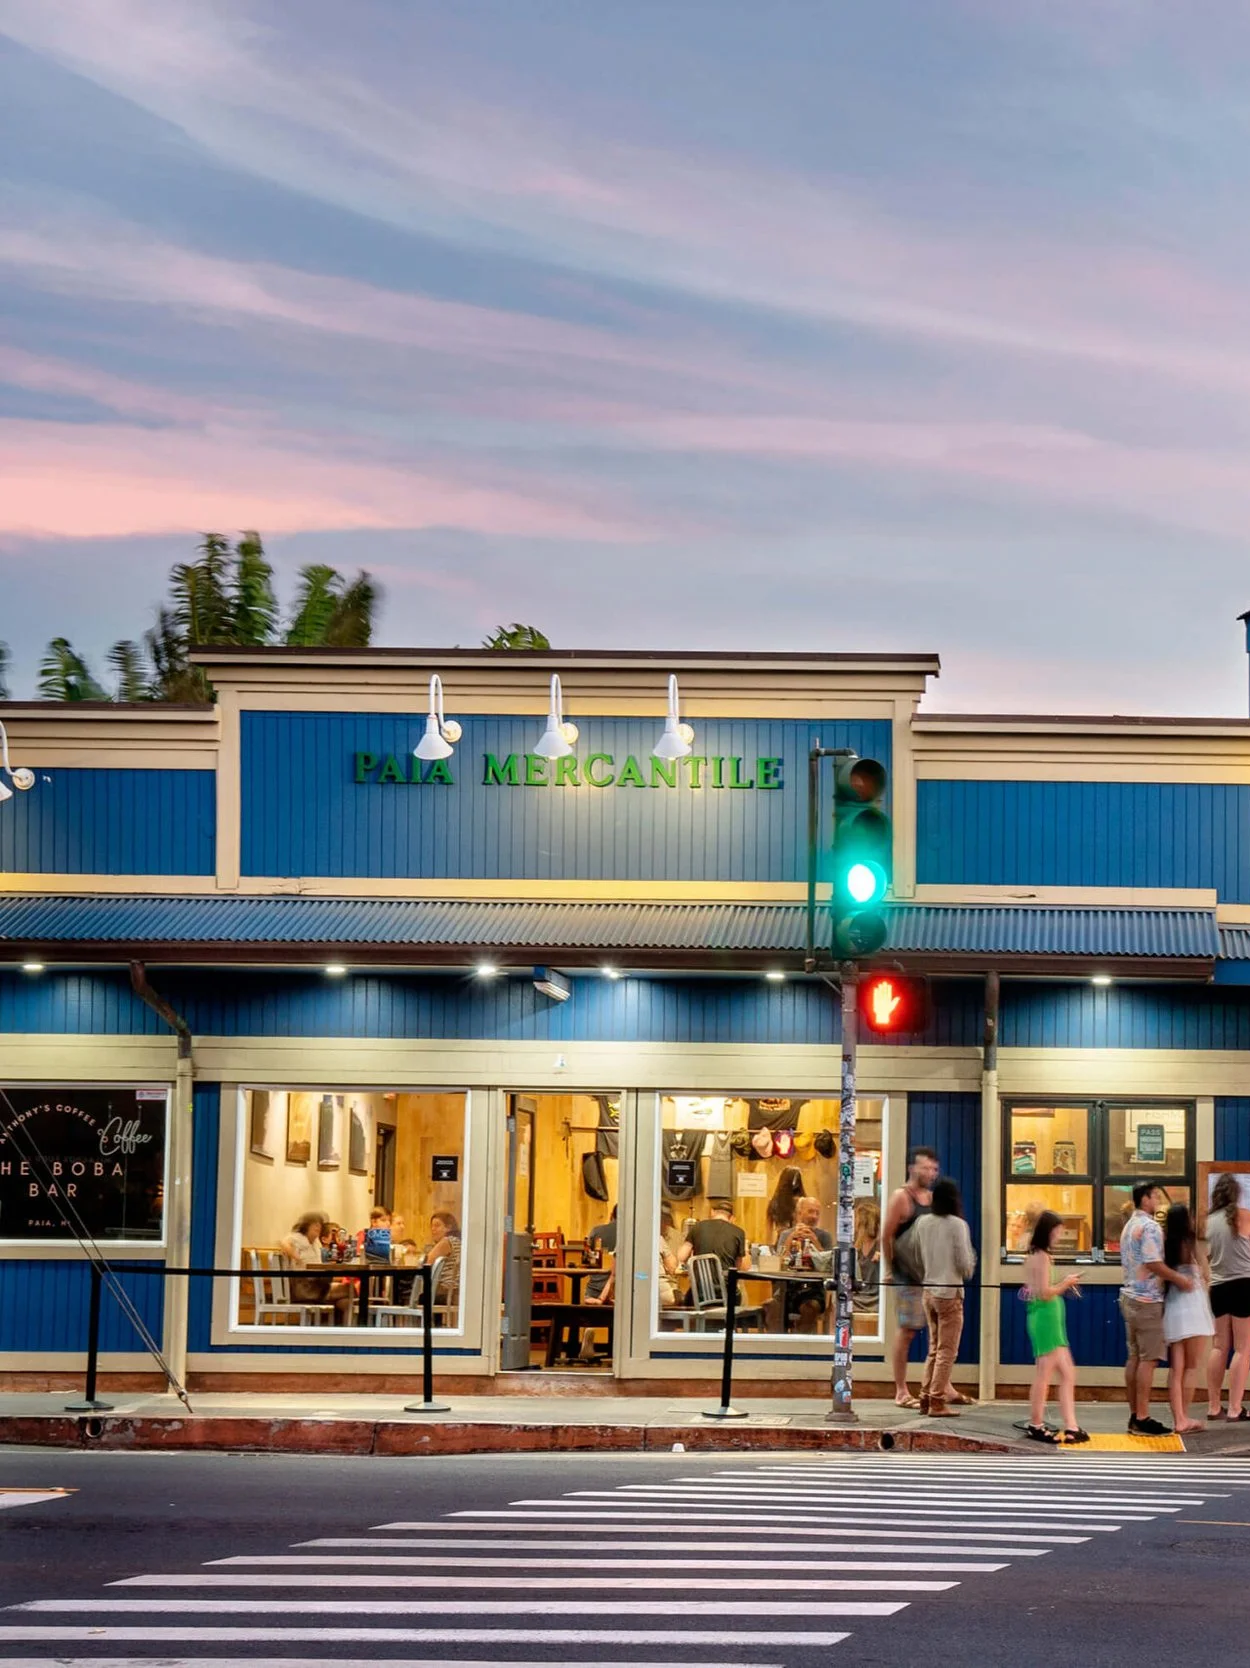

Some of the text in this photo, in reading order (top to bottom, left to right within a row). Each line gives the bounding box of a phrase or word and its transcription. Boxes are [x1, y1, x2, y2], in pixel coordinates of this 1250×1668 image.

[354, 752, 784, 789] PAIA MERCANTILE
[56, 1104, 96, 1127] COFFEE
[100, 1116, 152, 1155] Coffee
[0, 1162, 123, 1176] HE BOBA
[29, 1183, 77, 1197] BAR
